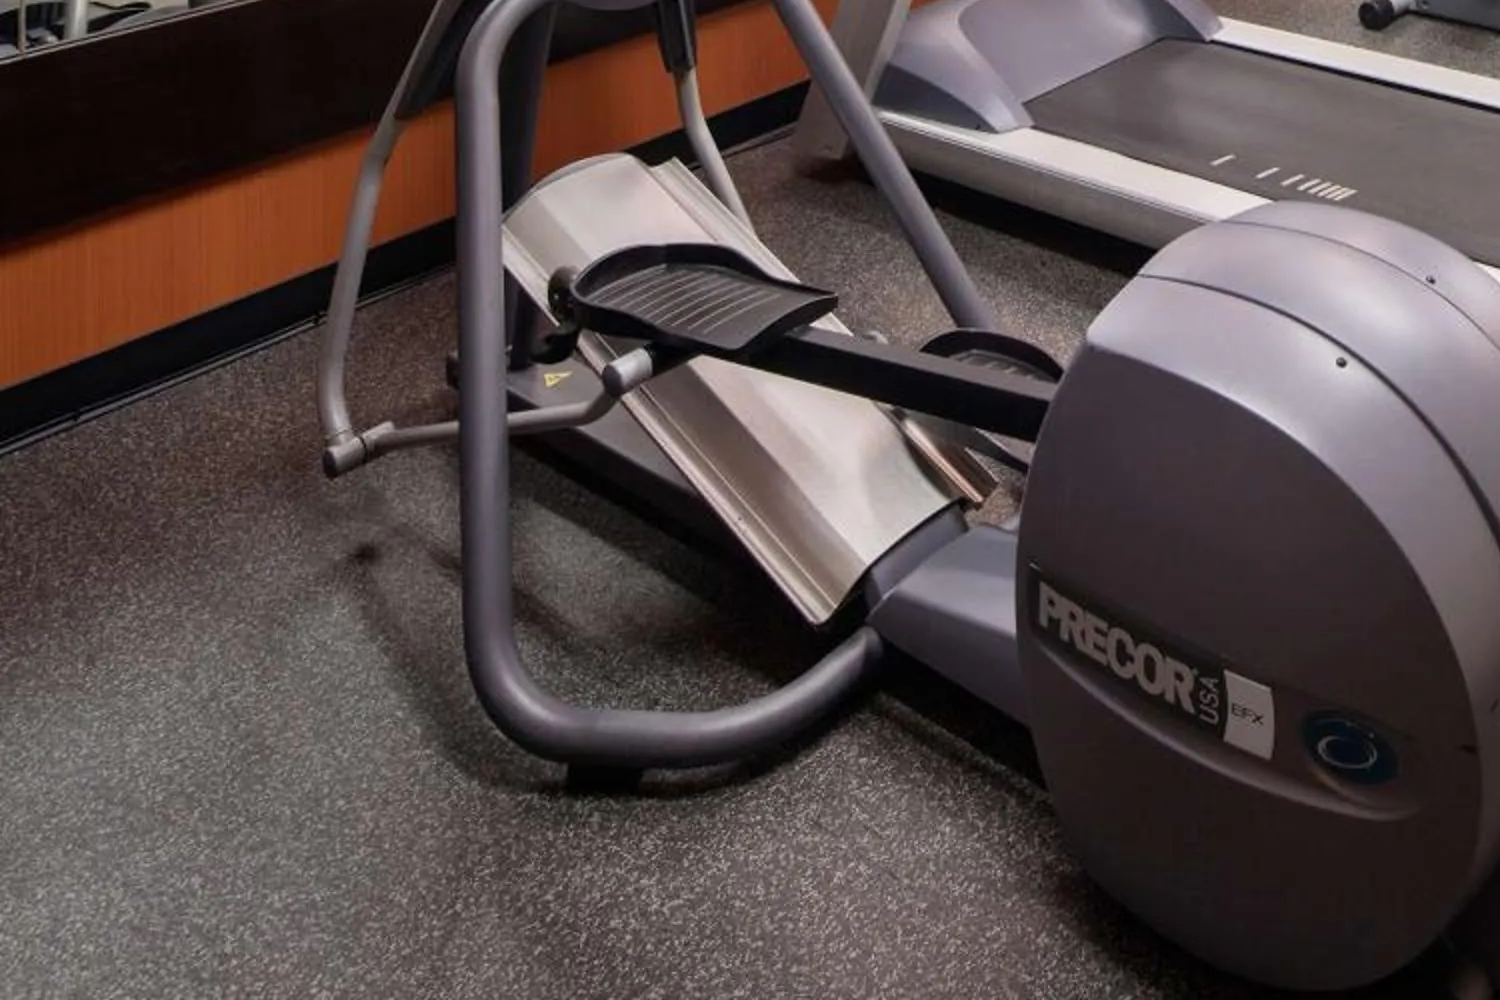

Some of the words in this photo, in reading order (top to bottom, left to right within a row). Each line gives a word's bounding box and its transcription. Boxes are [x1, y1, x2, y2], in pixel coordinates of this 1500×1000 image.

[1038, 580, 1197, 716] PRECOR
[1199, 676, 1219, 726] USA
[1231, 703, 1265, 727] EFX
